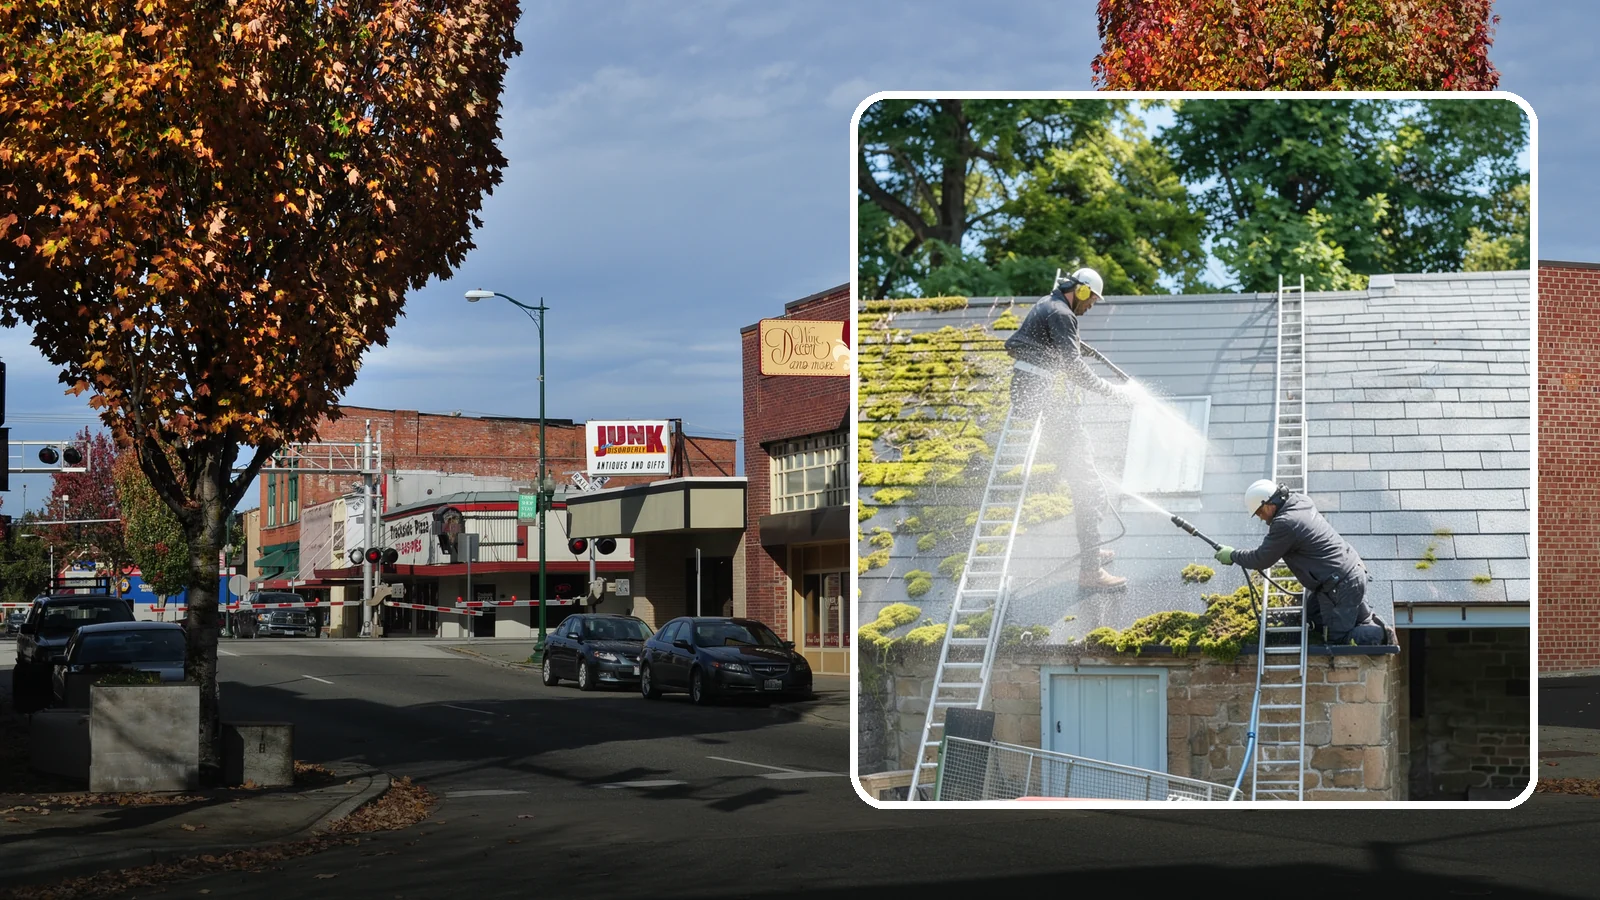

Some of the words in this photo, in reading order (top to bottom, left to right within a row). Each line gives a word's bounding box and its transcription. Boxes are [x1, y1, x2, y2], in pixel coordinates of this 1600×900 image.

[596, 425, 664, 457] JUNK
[607, 446, 646, 454] DISORDERLY
[597, 461, 628, 470] ANTIQUES
[631, 461, 644, 470] AND
[647, 460, 665, 469] GIFTS
